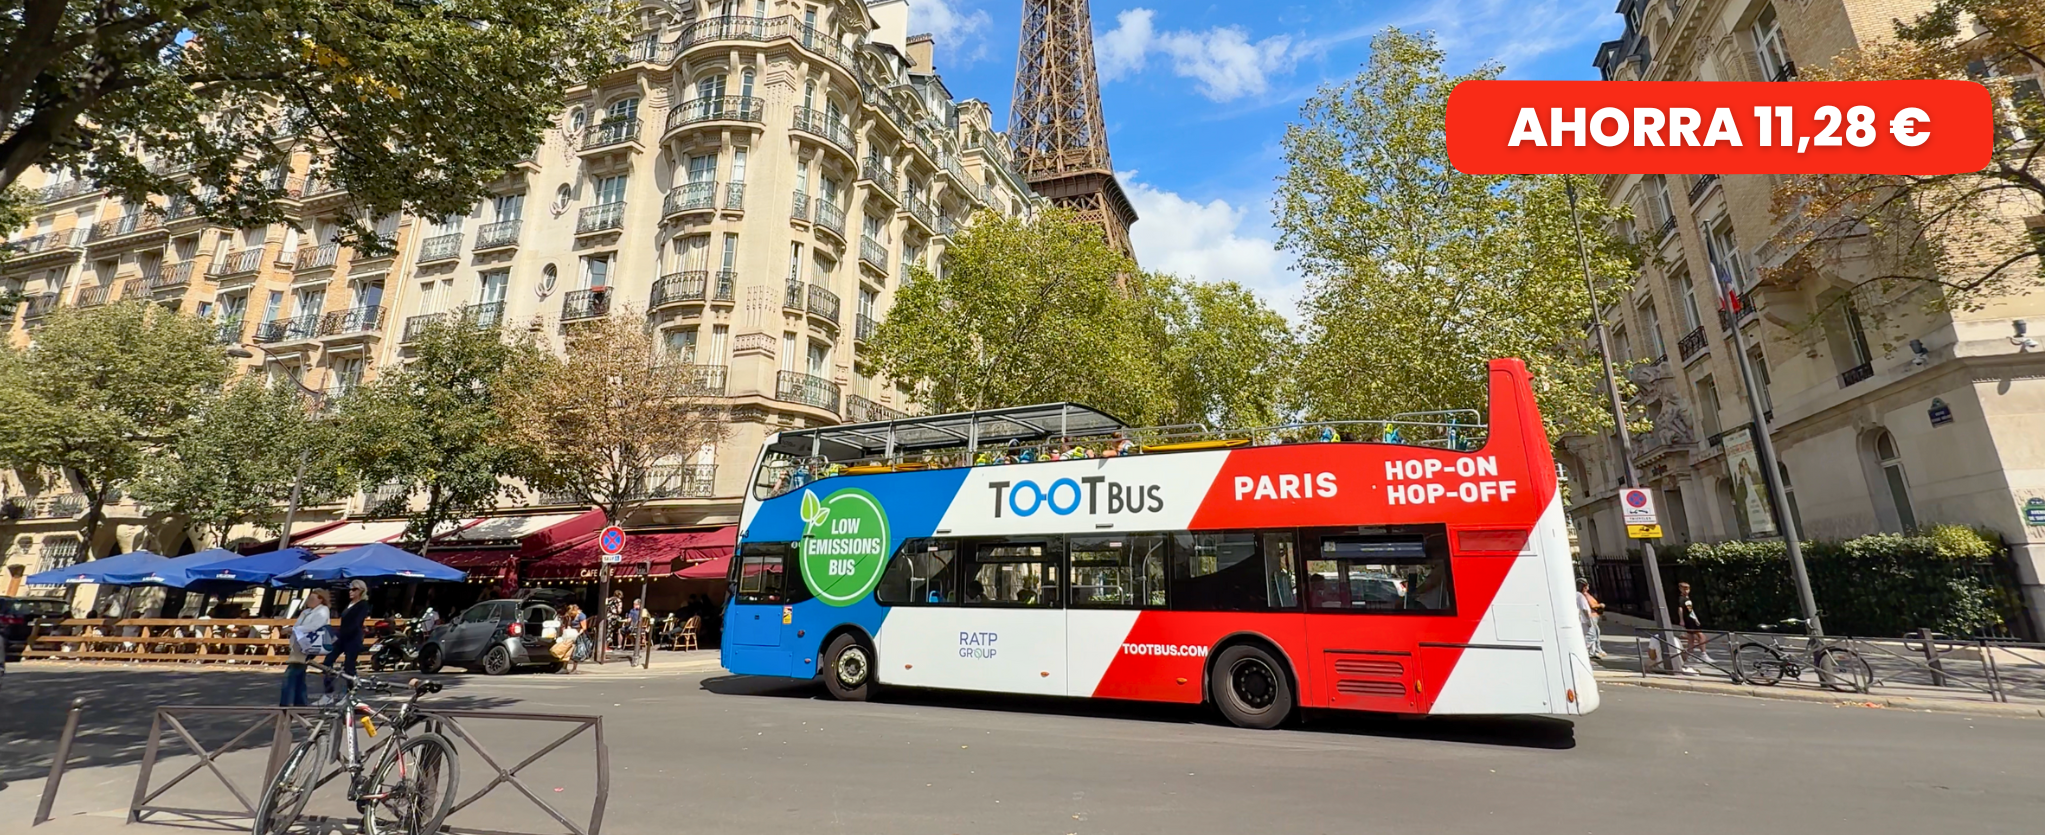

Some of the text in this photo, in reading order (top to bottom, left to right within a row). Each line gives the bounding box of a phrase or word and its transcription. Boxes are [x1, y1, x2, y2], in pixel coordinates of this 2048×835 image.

[1384, 455, 1498, 481] HOP-ON
[1234, 472, 1338, 501] PARIS
[1386, 480, 1517, 505] HOP-OFF
[831, 517, 861, 535] LOW
[808, 537, 881, 556] EMISSIONS
[828, 558, 856, 576] BUS
[959, 631, 998, 646] RATP
[958, 647, 997, 660] GROUP
[1122, 643, 1209, 658] TOOTBUS.COM
